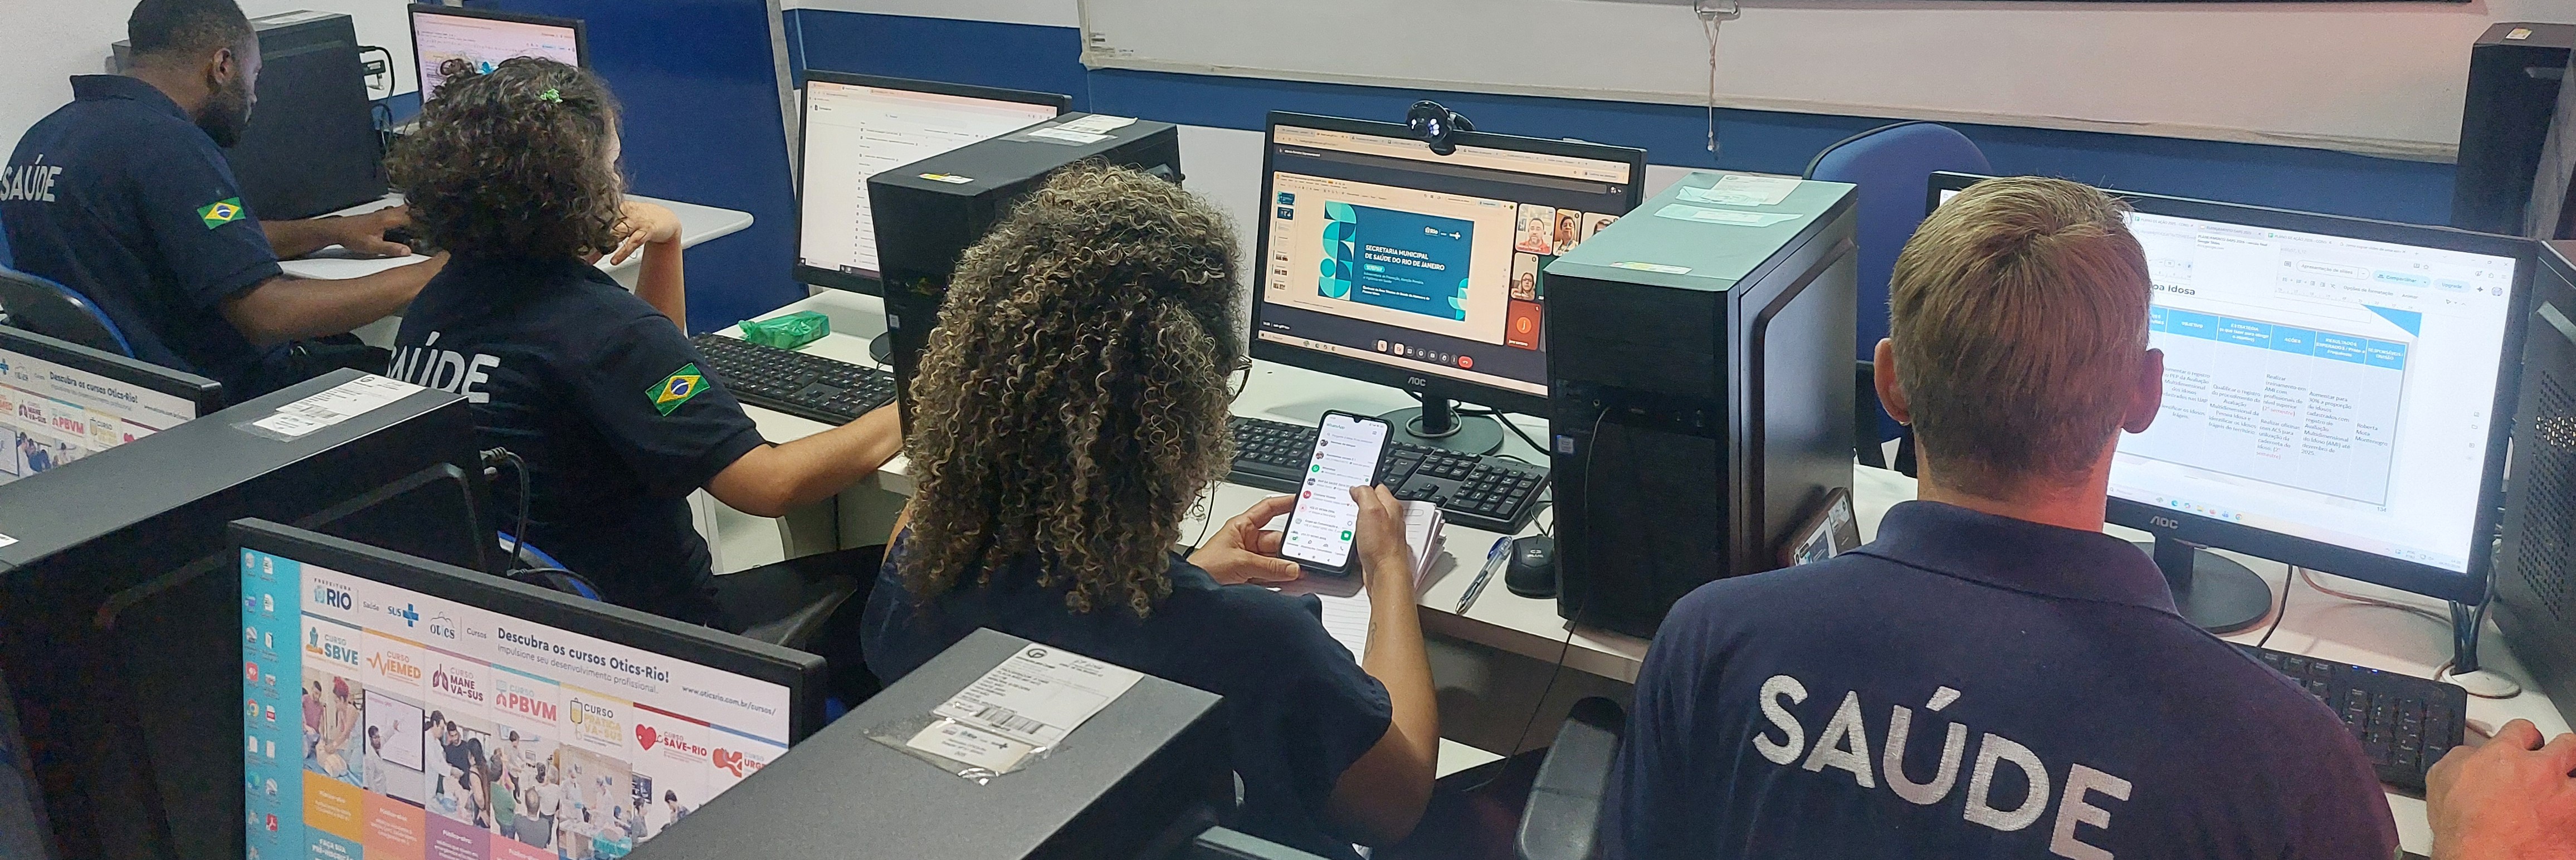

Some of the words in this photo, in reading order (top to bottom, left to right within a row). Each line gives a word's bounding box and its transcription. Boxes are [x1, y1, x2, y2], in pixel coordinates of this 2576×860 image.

[0, 154, 62, 202] SAÚDE
[1365, 245, 1398, 255] SECRETARIA
[1398, 250, 1429, 260] MUNICIPAL
[1373, 254, 1391, 262] SAÚDE
[1421, 262, 1445, 271] JANEIRO
[2301, 263, 2332, 272] Apresentação
[386, 331, 501, 403] AÚDE
[50, 371, 77, 387] Descubra
[86, 383, 106, 395] cursos
[107, 388, 138, 404] Otics-Rio!
[1408, 377, 1426, 387] AOC
[2165, 379, 2206, 390] Multidimensional
[2265, 382, 2297, 390] treinamento
[2213, 384, 2236, 393] Qualificar
[2219, 392, 2253, 402] procedimento
[2263, 394, 2295, 403] profissionais
[2309, 392, 2335, 400] Aumentar
[2210, 403, 2252, 415] Multidimensional
[2223, 399, 2247, 407] Avaliação
[2325, 400, 2351, 409] proporção
[2270, 408, 2295, 417] semestre)
[2306, 411, 2336, 420] cadastrados
[59, 417, 84, 434] PBVM
[2233, 426, 2255, 434] território
[2305, 423, 2329, 432] Avaliação
[2304, 430, 2349, 442] Multidimensional
[2355, 436, 2388, 446] Montenegro
[2258, 438, 2283, 447] caderneta
[2302, 443, 2328, 452] dezembro
[2256, 451, 2281, 460] semestre)
[2150, 515, 2178, 530] AOC
[326, 588, 352, 610] RIO
[388, 606, 401, 617] SUS
[466, 628, 487, 639] Cursos
[325, 634, 347, 646] CURSO
[324, 643, 359, 666] SBVE
[387, 651, 409, 663] CURSO
[498, 627, 549, 651] Descubra
[553, 646, 565, 656] os
[569, 649, 606, 666] cursos
[610, 657, 669, 683] Otics-Rio!
[387, 661, 421, 679] IEMED
[450, 667, 474, 679] CURSO
[497, 644, 535, 661] Impulsione
[536, 656, 548, 664] seu
[550, 658, 612, 681] desenvolvimento
[614, 676, 659, 694] profissional.
[450, 675, 475, 690] MANE
[451, 684, 483, 702] VA-SUS
[510, 685, 535, 697] CURSO
[509, 692, 557, 721] PBVM
[584, 703, 614, 719] CURSO
[664, 731, 684, 741] CURSO
[664, 740, 707, 756] SAVE-RIO
[1752, 675, 2133, 860] SAÚDE
